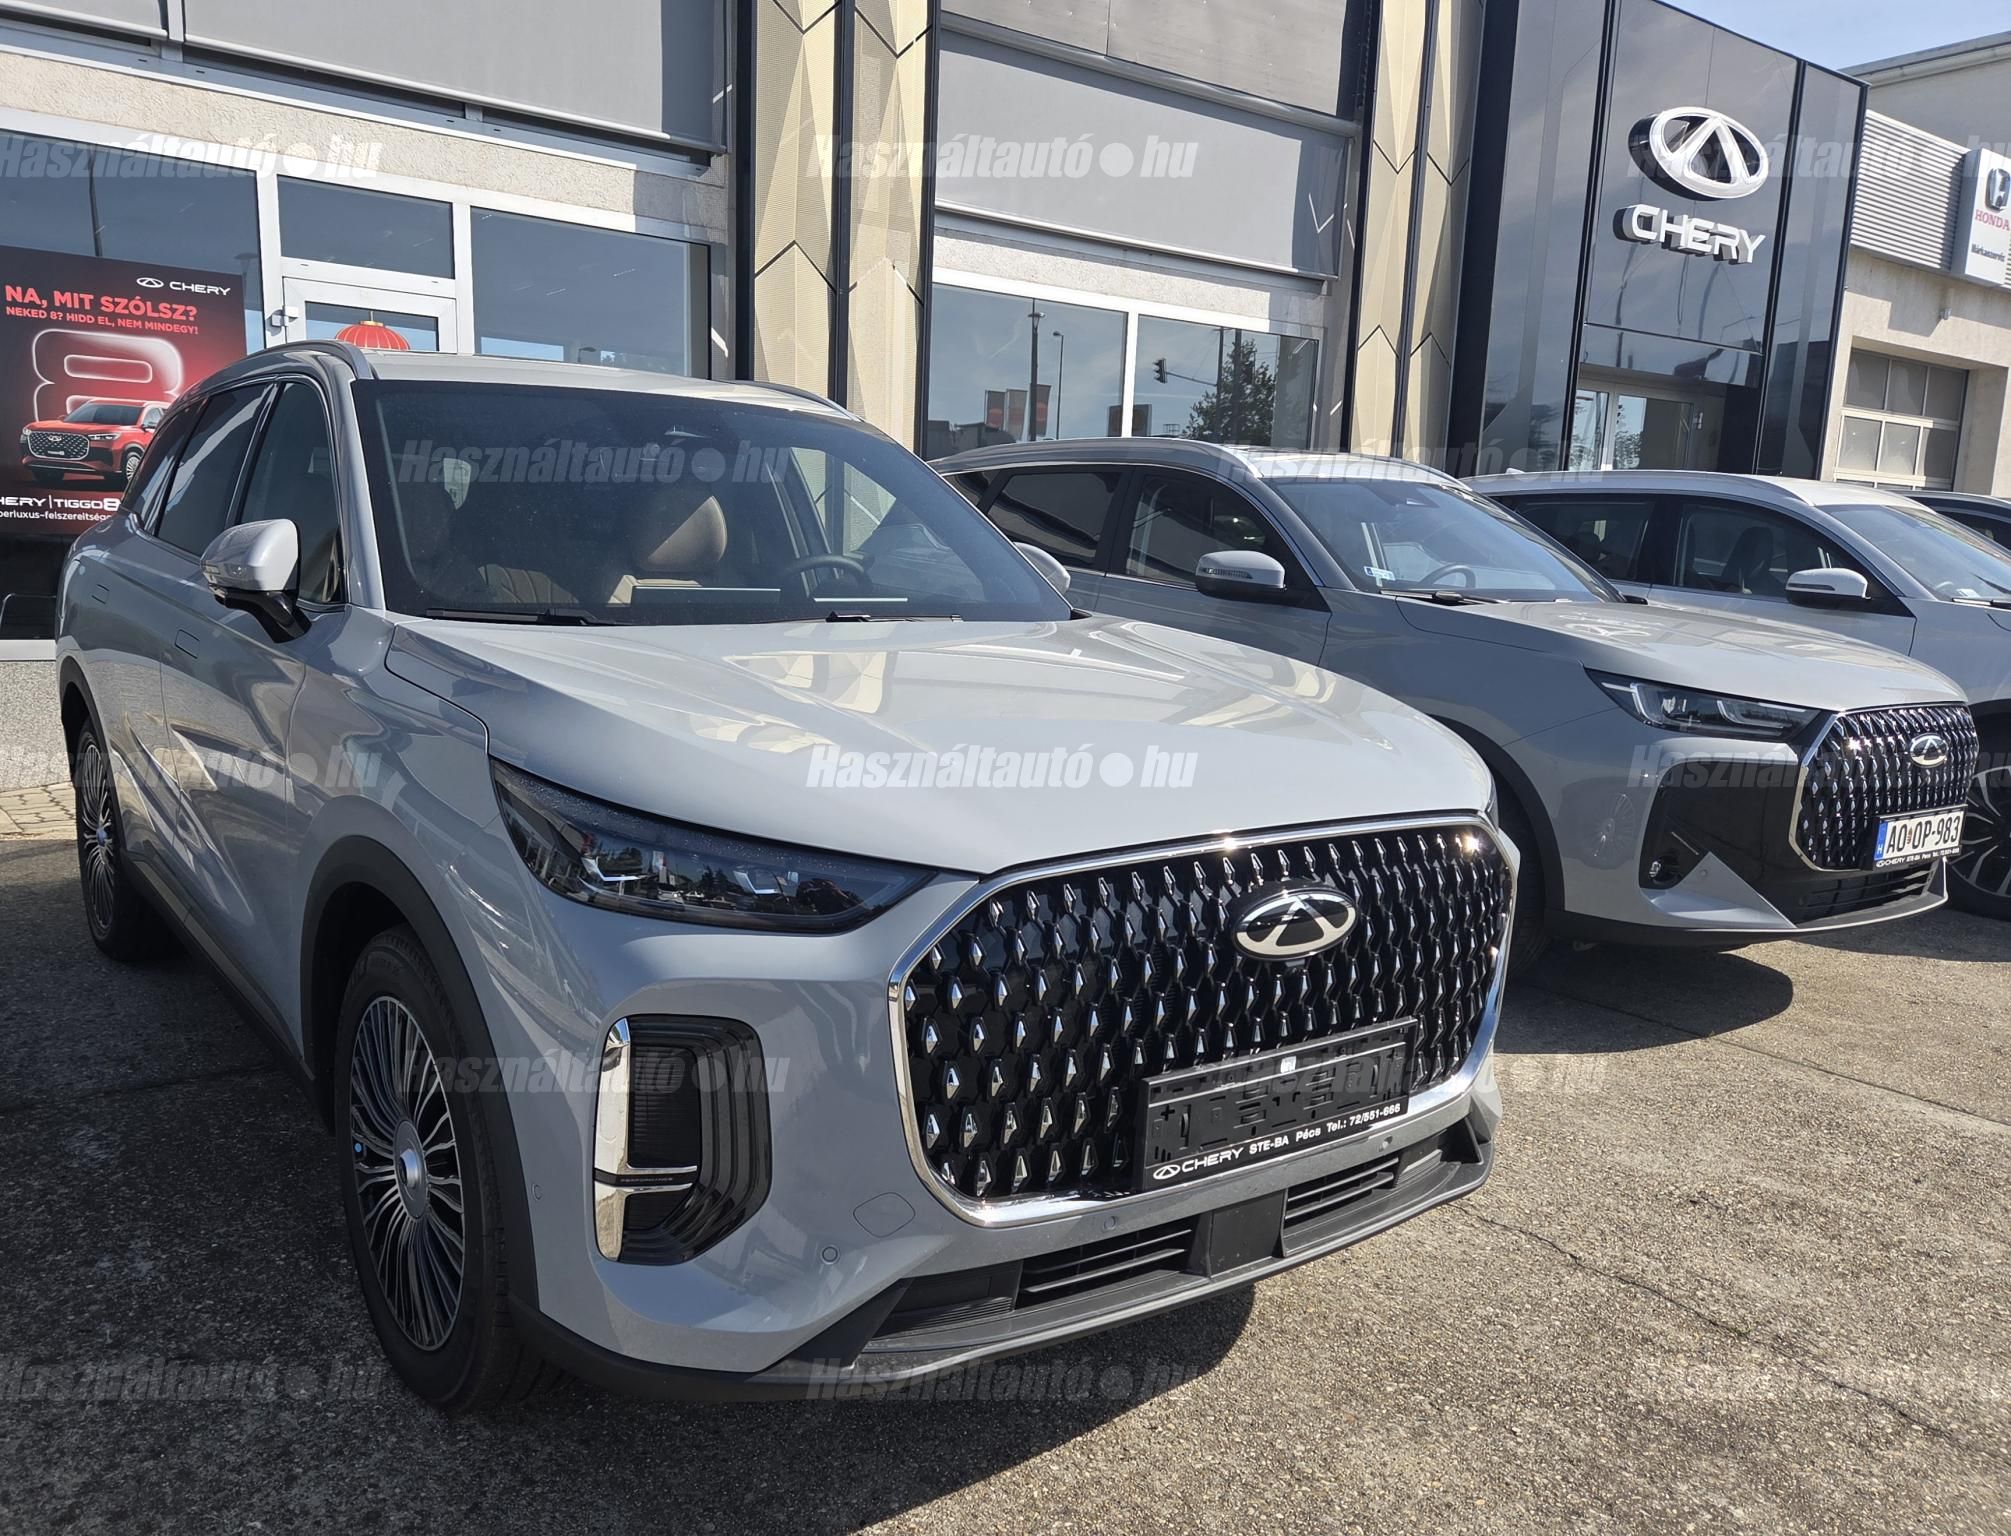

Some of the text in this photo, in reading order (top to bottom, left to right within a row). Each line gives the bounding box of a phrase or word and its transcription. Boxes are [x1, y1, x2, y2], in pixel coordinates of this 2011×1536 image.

[1622, 203, 1766, 263] CHERY
[1975, 209, 2010, 231] HONDA
[5, 285, 197, 321] NA, MIT SZÓLSZ?
[169, 281, 231, 296] CHERY
[6, 306, 199, 334] NEKED 8? HIDD EL, NEM MINDEGY!
[1181, 1147, 1244, 1173] CHERY
[1249, 1135, 1289, 1155] STE-BA
[1295, 1127, 1321, 1142] Pécs
[1326, 1119, 1347, 1133] Tel.:
